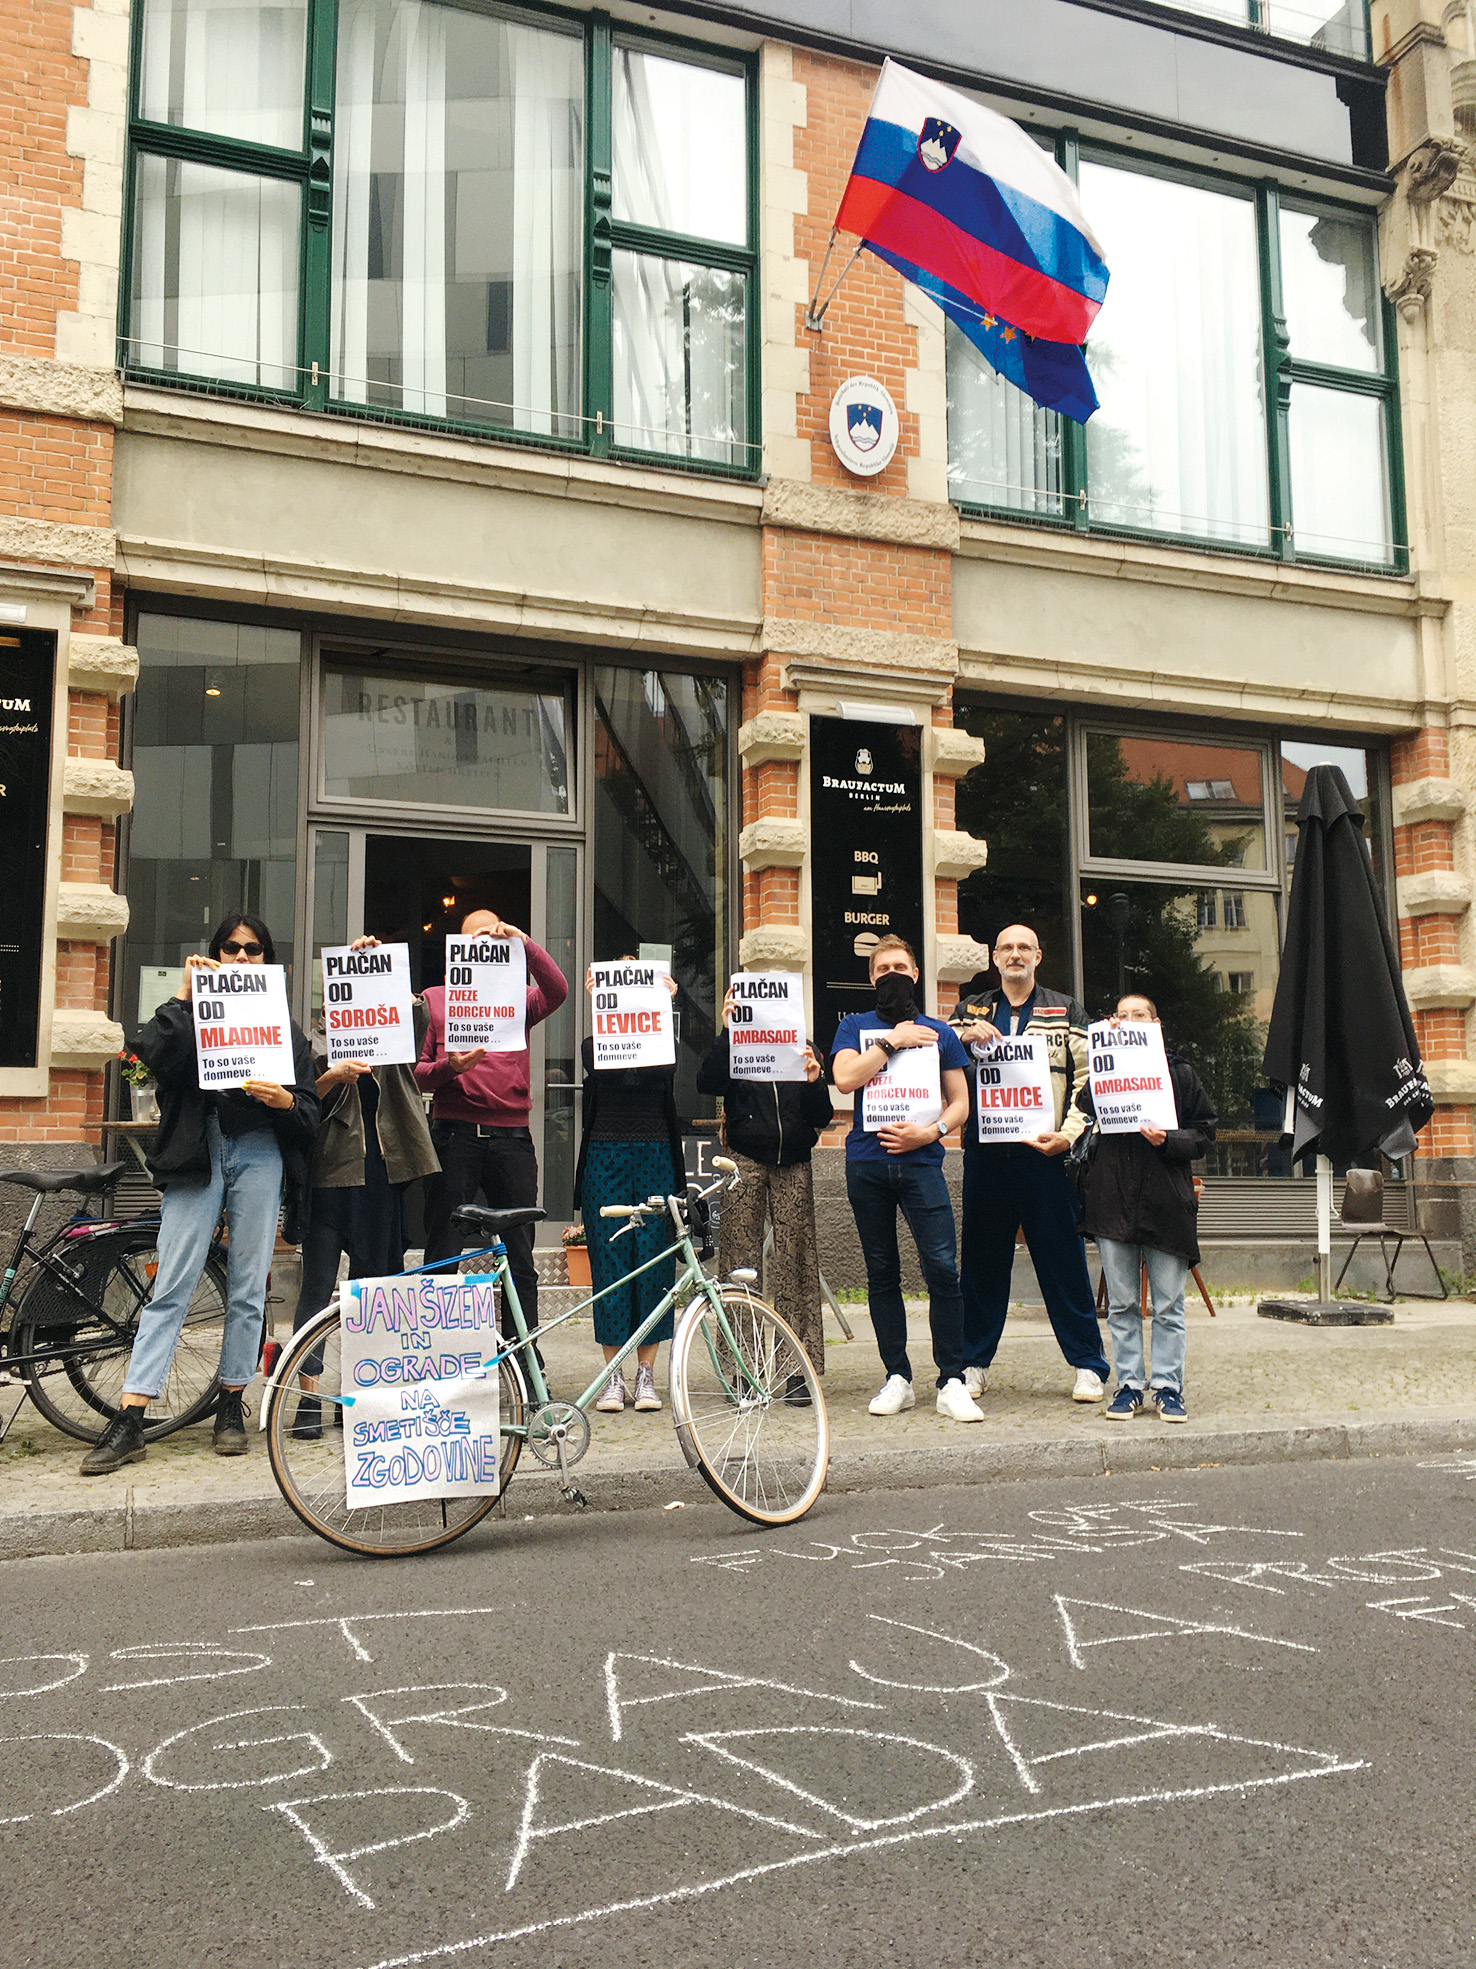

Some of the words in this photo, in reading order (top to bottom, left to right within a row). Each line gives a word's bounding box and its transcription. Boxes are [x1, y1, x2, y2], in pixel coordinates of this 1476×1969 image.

[358, 692, 538, 738] RESTAURANT
[823, 775, 906, 795] BRAUFACTUM
[848, 792, 881, 801] BERLIN
[854, 850, 879, 865] BBQ
[844, 912, 890, 926] BURGER
[450, 940, 510, 963] PLAČAN
[327, 951, 392, 976] PLAČAN
[196, 969, 267, 994] PLAČAN
[450, 967, 472, 984] OD
[595, 966, 654, 988] PLAČAN
[329, 983, 352, 1002] OD
[449, 990, 478, 1002] ZVEZE
[732, 978, 788, 999] PLAČAN
[199, 1001, 225, 1020] OD
[596, 993, 618, 1010] OD
[330, 1005, 400, 1029] SOROŠA
[449, 1005, 491, 1018] BORCEV
[493, 1005, 515, 1018] NOB
[732, 1005, 753, 1023] OD
[449, 1022, 460, 1032] To
[462, 1024, 473, 1032] so
[474, 1021, 494, 1032] vaše
[597, 1011, 662, 1034] LEVICE
[201, 1025, 282, 1048] MLADINE
[331, 1037, 342, 1048] To
[345, 1038, 356, 1047] so
[358, 1035, 379, 1046] vaše
[733, 1030, 798, 1044] AMBASADE
[1092, 1028, 1148, 1049] PLAČAN
[597, 1042, 608, 1052] To
[609, 1043, 620, 1051] so
[622, 1041, 642, 1050] vaše
[203, 1057, 215, 1069] To
[217, 1058, 229, 1068] so
[231, 1054, 255, 1066] vaše
[597, 1052, 637, 1062] domneve
[733, 1055, 743, 1064] To
[744, 1056, 754, 1064] so
[755, 1053, 776, 1063] vaše
[1093, 1055, 1115, 1073] OD
[980, 1067, 1001, 1085] OD
[867, 1088, 907, 1100] BORCEV
[909, 1088, 929, 1099] NOB
[1094, 1077, 1164, 1095] AMBASADE
[890, 1102, 910, 1111] vaše
[981, 1087, 1043, 1108] LEVICE
[1098, 1106, 1109, 1115] To
[1111, 1106, 1121, 1114] so
[1123, 1103, 1142, 1113] vaše
[981, 1115, 991, 1124] To
[993, 1116, 1002, 1124] so
[1004, 1114, 1024, 1124] vaše
[346, 1286, 418, 1334] JAN
[420, 1279, 495, 1330] ŠIZEM
[401, 1331, 431, 1350] IN
[354, 1352, 486, 1387] OGRADE
[401, 1389, 440, 1410] NA
[353, 1409, 471, 1446] SMETIŠČE
[352, 1435, 496, 1488] ZGODOVINE
[690, 1523, 1016, 1573] FUCK
[1027, 1499, 1198, 1526] OFF
